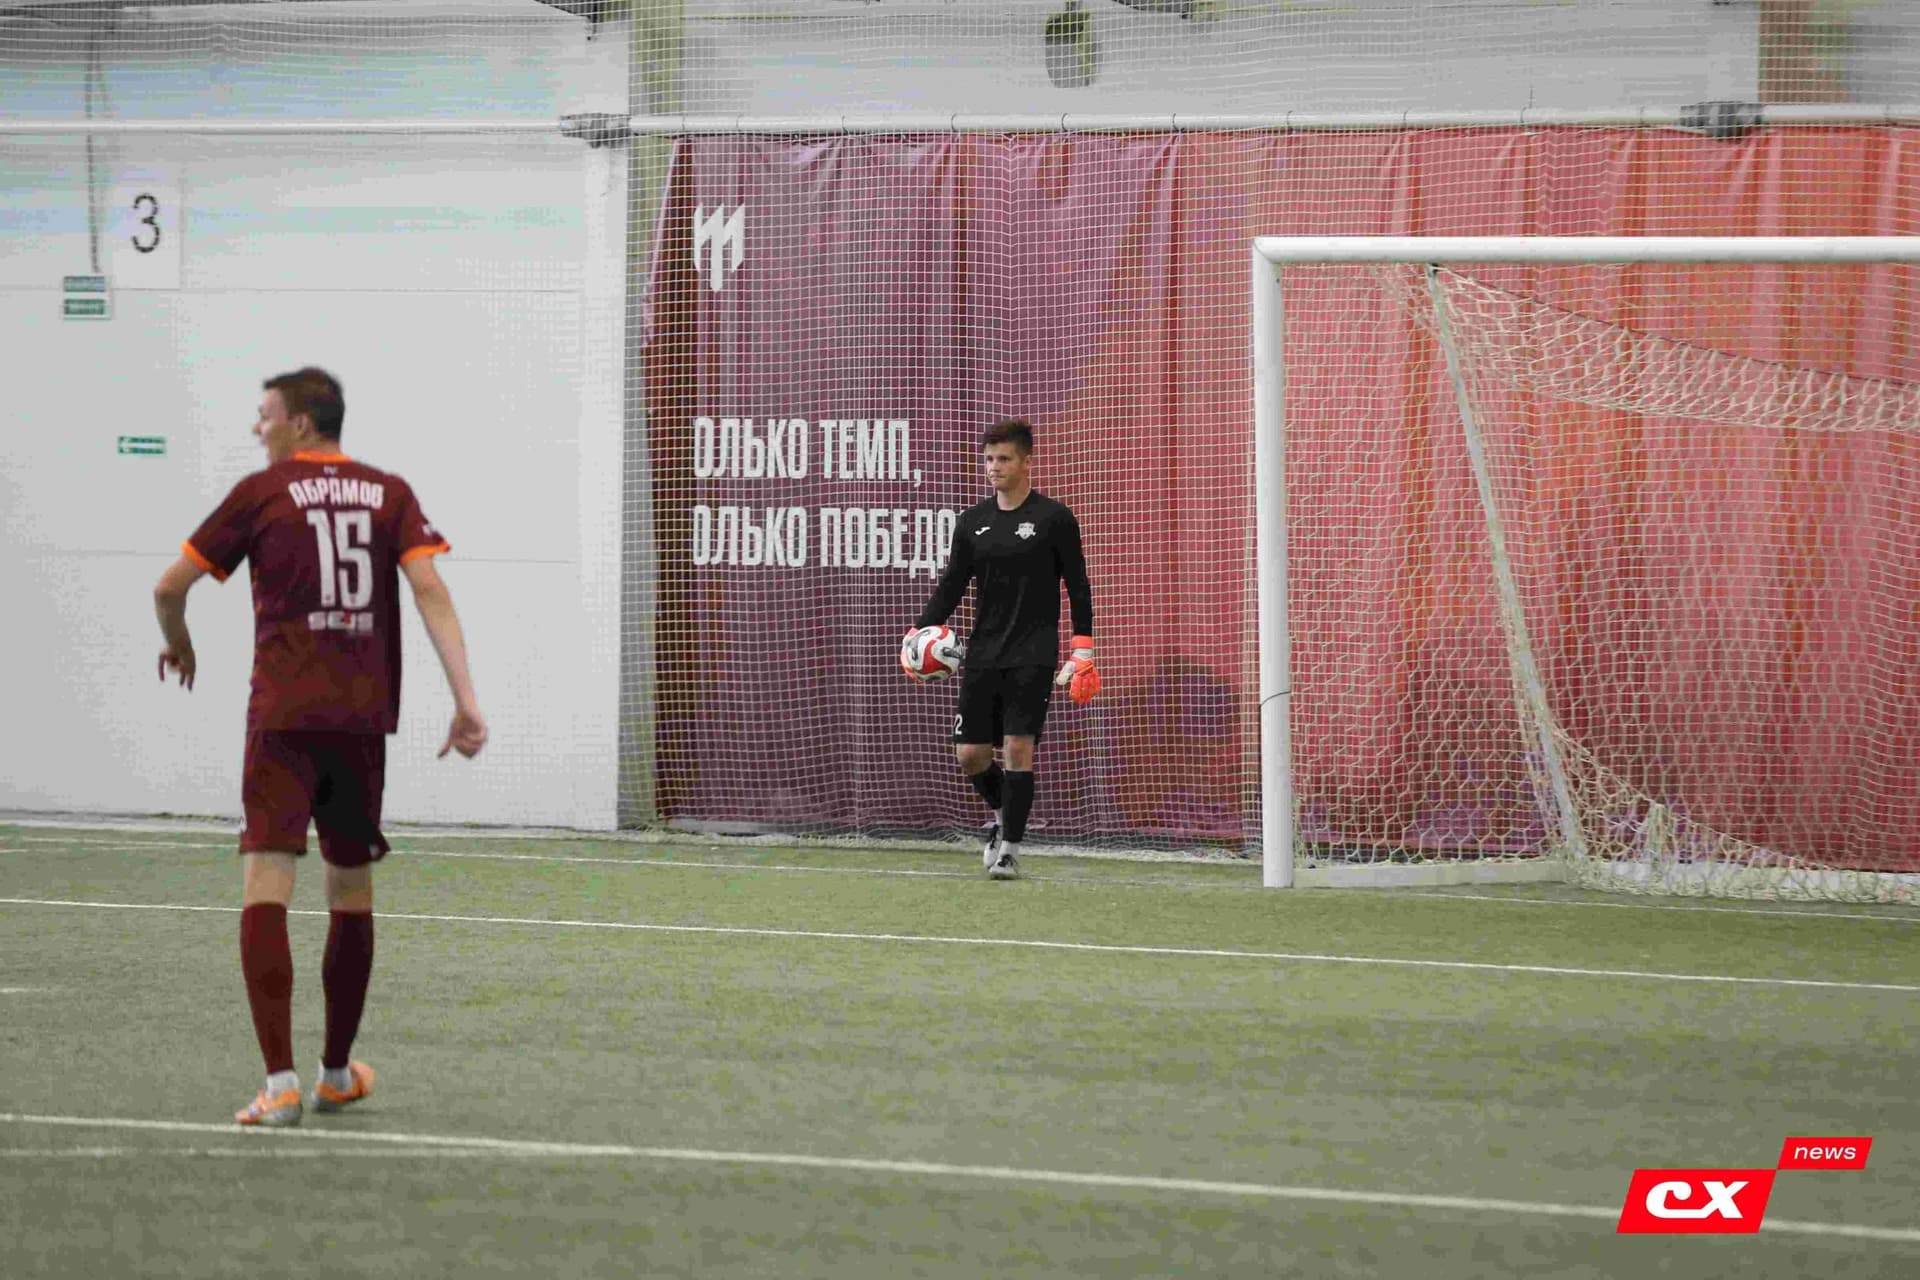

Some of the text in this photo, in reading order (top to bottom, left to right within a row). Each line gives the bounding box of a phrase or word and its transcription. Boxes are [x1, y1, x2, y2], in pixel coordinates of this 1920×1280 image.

[132, 193, 160, 253] 3
[694, 417, 922, 487] ОЛЬКО ТЕМП,
[288, 477, 384, 509] АБРАМОВ
[306, 509, 373, 610] 15
[693, 505, 807, 567] ОЛЬКО
[953, 713, 963, 735] 2
